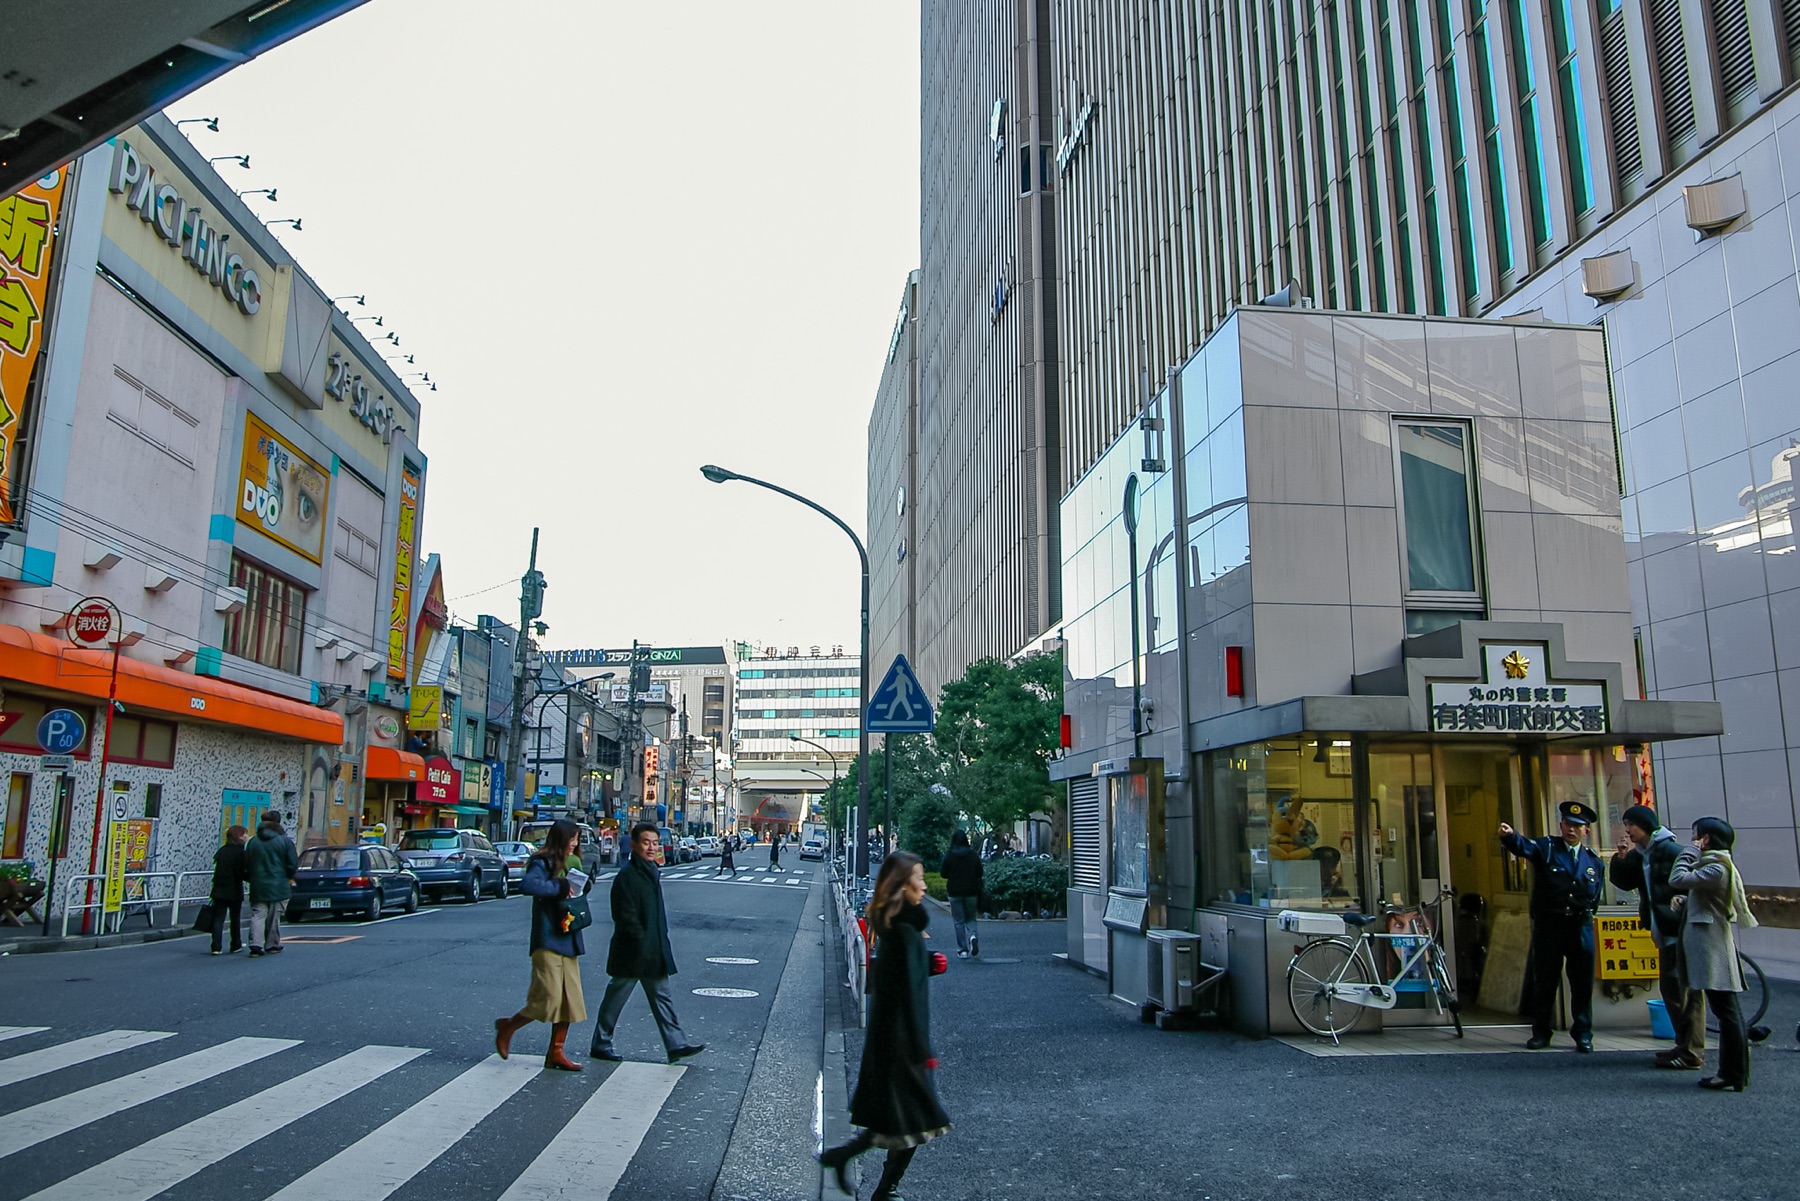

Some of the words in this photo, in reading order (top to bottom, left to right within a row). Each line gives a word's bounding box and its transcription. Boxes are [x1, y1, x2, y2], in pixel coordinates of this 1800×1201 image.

[109, 139, 261, 316] PACHINCO
[242, 477, 280, 526] DUO
[77, 616, 109, 631] 消火栓
[651, 650, 679, 661] GINZA
[1469, 686, 1567, 702] 丸の内警察署
[190, 697, 206, 710] DUO
[1433, 703, 1605, 731] 有楽町駅前交番
[47, 719, 67, 747] P
[59, 734, 73, 748] 60
[1604, 938, 1627, 950] 死亡
[1641, 958, 1657, 970] 18
